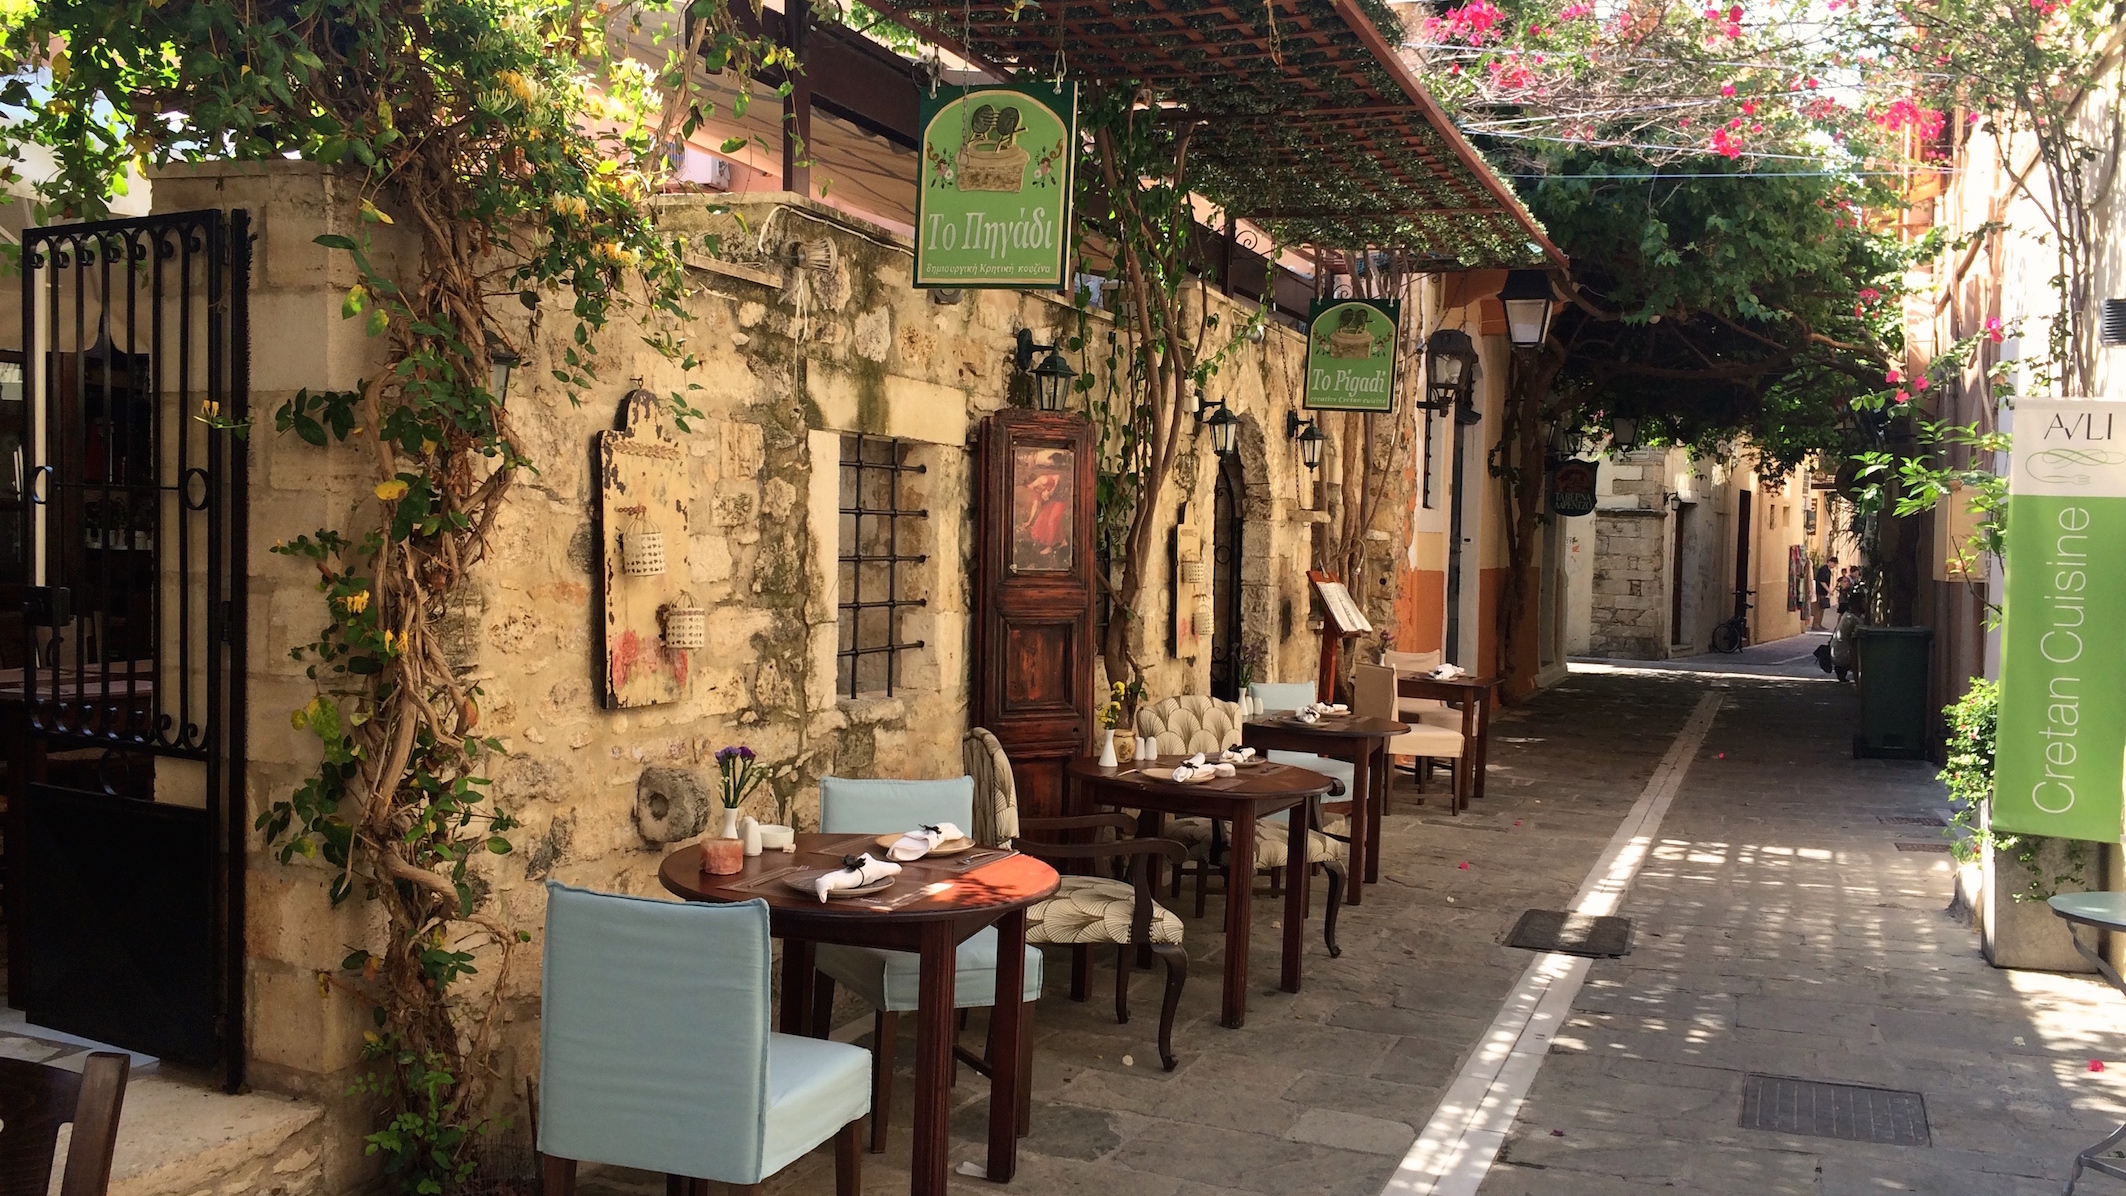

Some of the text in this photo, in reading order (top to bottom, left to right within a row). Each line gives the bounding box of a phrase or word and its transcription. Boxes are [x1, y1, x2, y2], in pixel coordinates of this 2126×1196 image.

[927, 206, 1053, 259] Το Πηγάδι
[926, 263, 1051, 275] δημιουργική Κρητική κουζίνα
[1311, 368, 1387, 398] To Pigadi
[2043, 413, 2112, 441] AVLI
[2031, 506, 2090, 815] Cretan Cuisine
